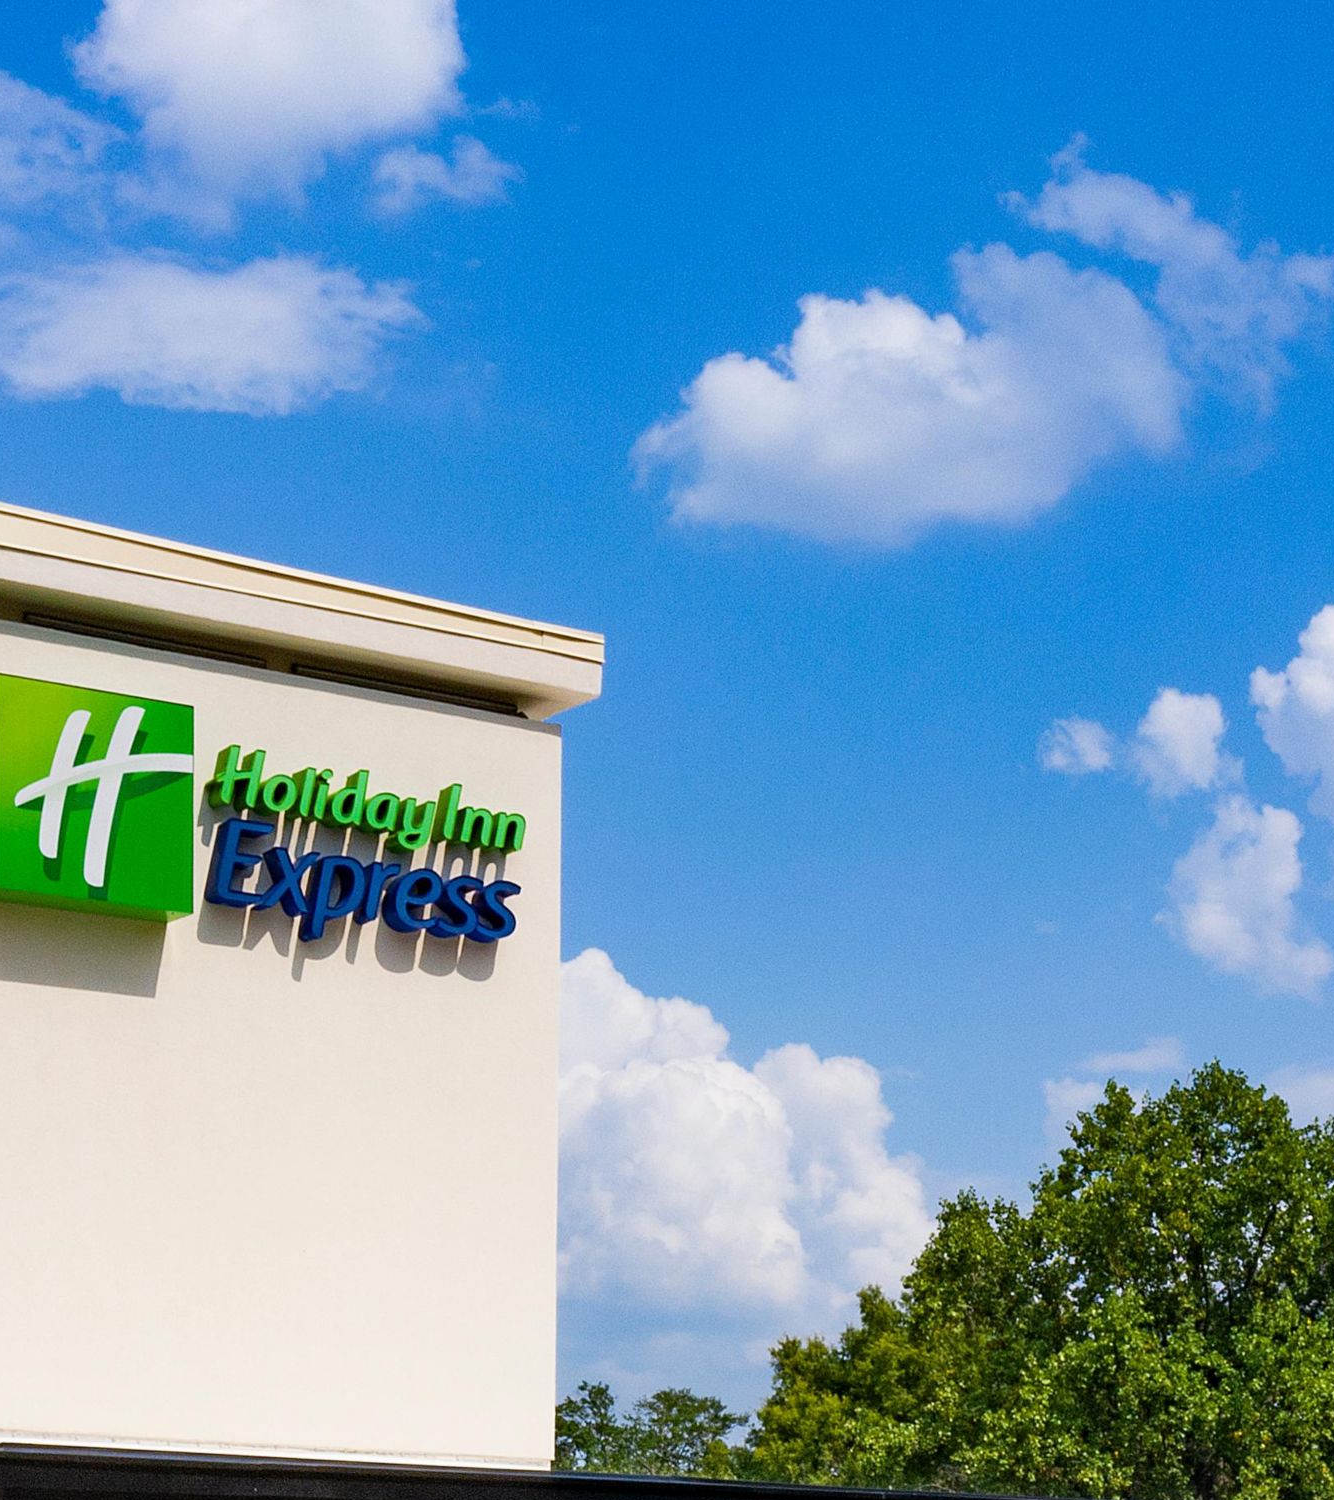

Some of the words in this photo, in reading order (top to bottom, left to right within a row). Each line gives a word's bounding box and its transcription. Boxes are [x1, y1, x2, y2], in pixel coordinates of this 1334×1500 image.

[208, 744, 436, 853] Holiday
[431, 783, 527, 855] Inn
[204, 817, 522, 943] Express
